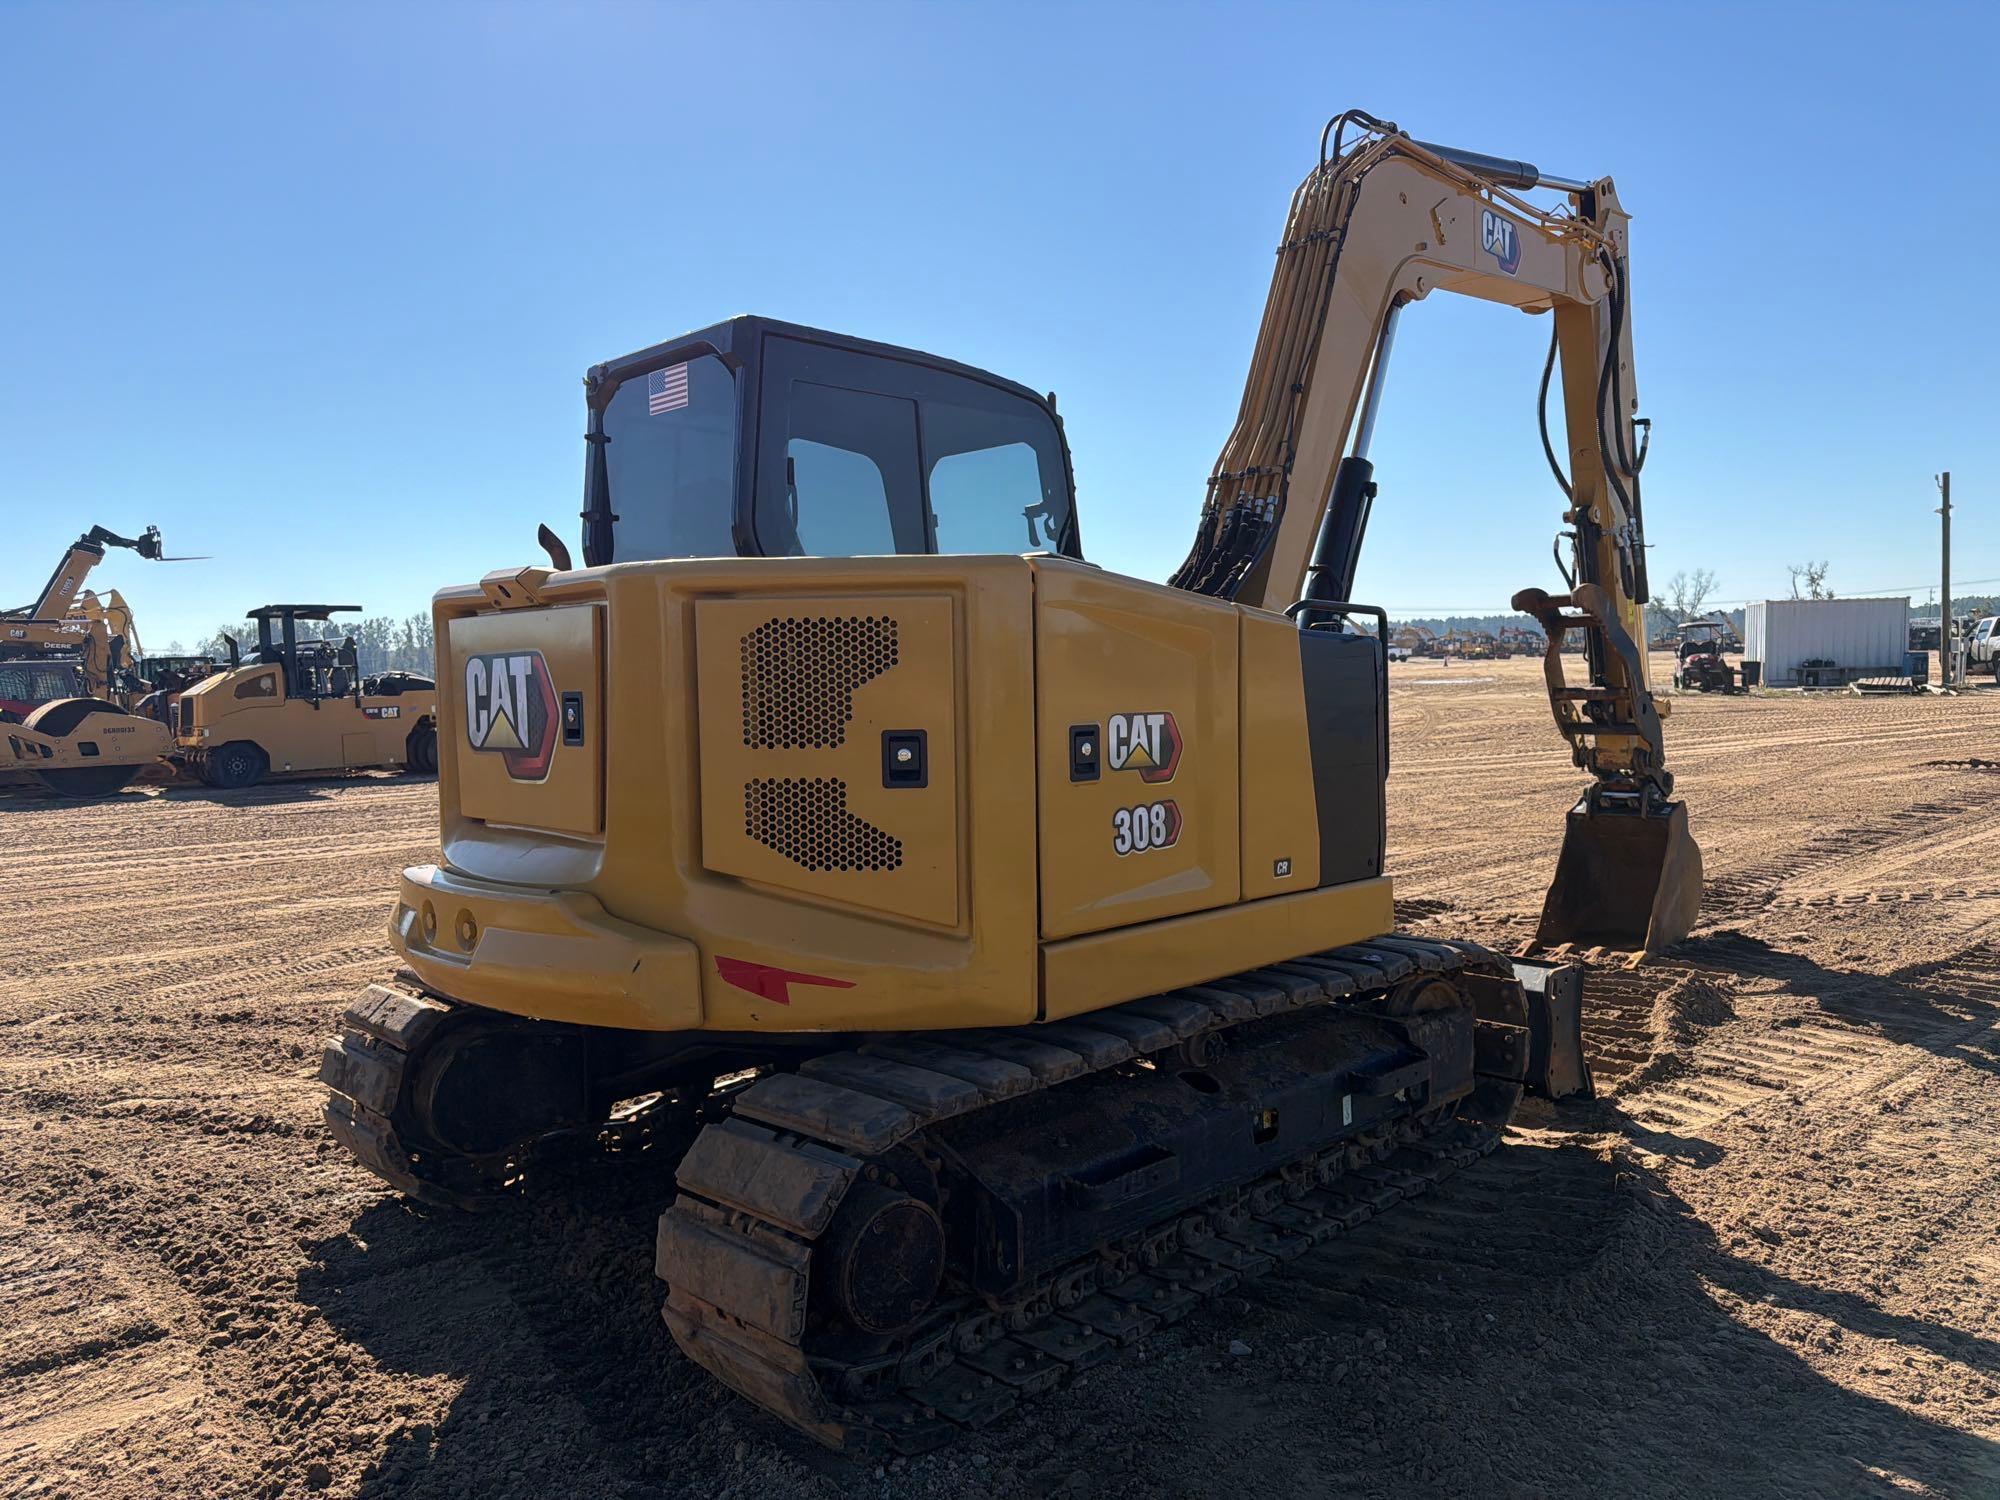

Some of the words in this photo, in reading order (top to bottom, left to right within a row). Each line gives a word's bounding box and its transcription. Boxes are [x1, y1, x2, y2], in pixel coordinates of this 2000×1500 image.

[1482, 211, 1512, 260] CAT
[10, 629, 24, 638] CAT
[381, 707, 398, 718] CAT
[466, 656, 532, 748] CAT
[1108, 714, 1165, 769] CAT
[1114, 803, 1166, 854] 308
[1276, 861, 1288, 874] CR
